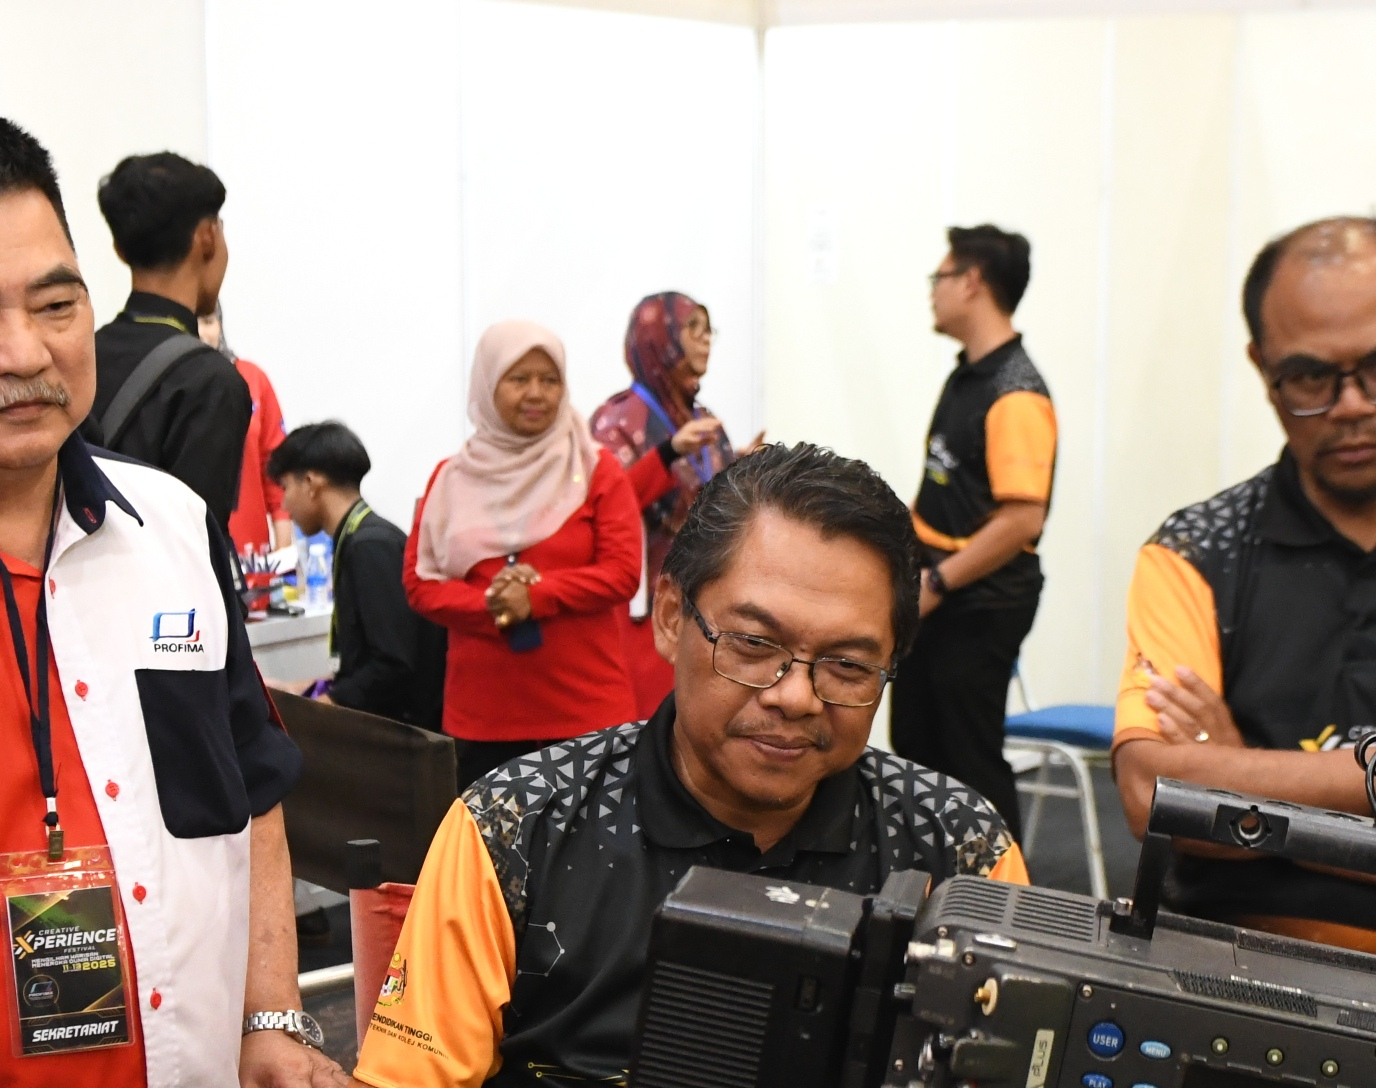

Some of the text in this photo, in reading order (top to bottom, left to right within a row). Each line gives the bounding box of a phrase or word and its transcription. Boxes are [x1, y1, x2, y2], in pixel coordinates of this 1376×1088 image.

[154, 643, 204, 653] PROFIMA
[38, 926, 80, 936] CREATIVE
[13, 928, 117, 959] XPERIENCE
[64, 945, 96, 953] FESTIVAL
[82, 959, 116, 971] 2025
[32, 1020, 119, 1042] SEKRETARIAT
[372, 1013, 433, 1042] ENDIDIKAN TINGGI
[398, 1035, 415, 1046] KOLEJ
[1092, 1033, 1118, 1048] USER
[1145, 1046, 1166, 1057] MENU
[1088, 1078, 1107, 1088] PLAY
